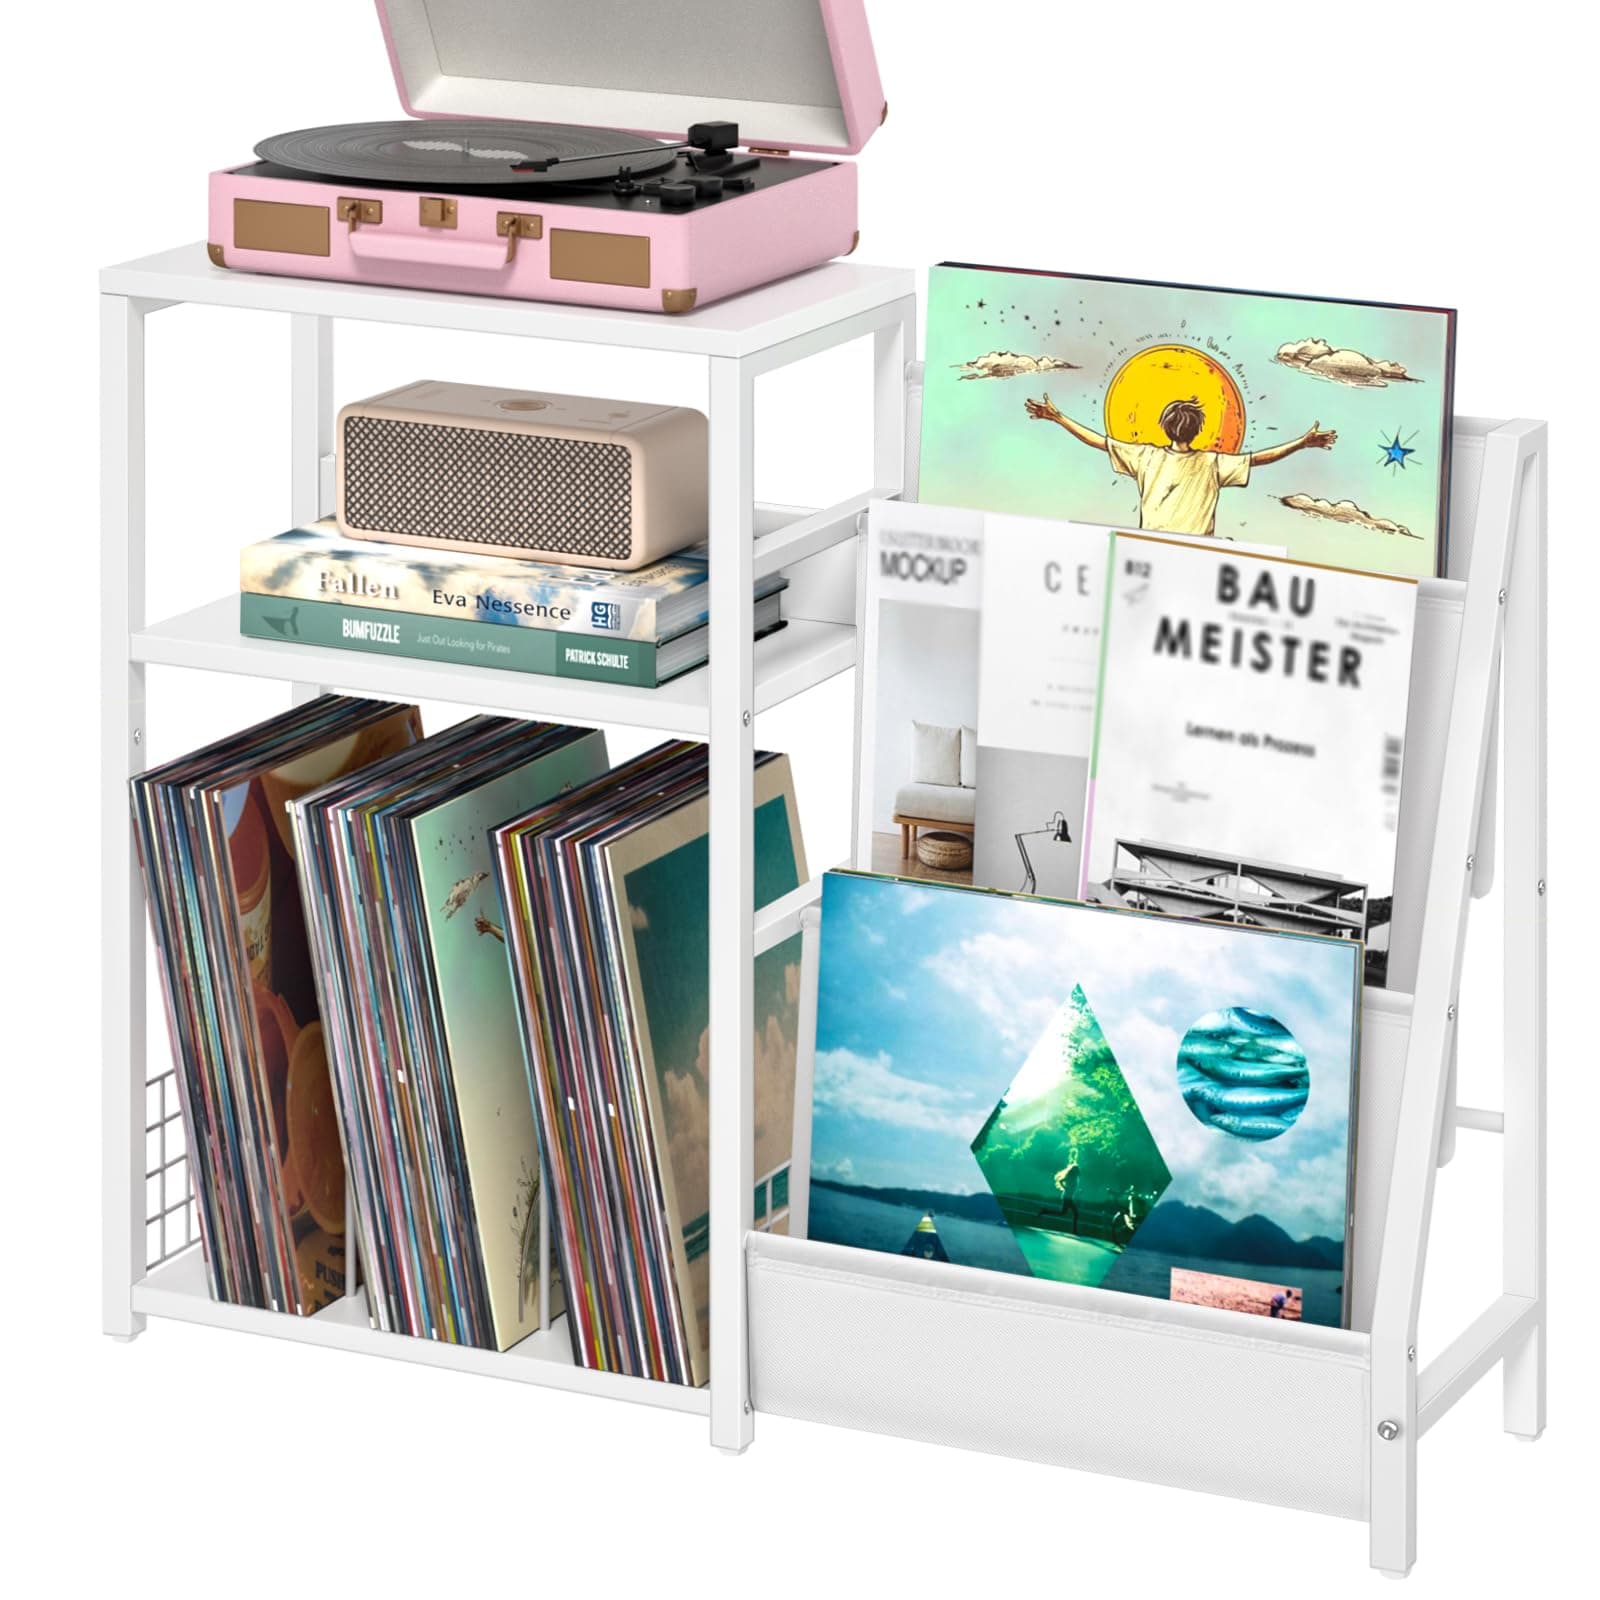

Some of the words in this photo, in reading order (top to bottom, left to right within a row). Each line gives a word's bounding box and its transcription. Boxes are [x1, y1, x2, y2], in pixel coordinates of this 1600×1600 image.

[880, 550, 968, 586] MOCKUP
[319, 571, 401, 602] Fallen
[1217, 562, 1316, 618] BAU
[432, 588, 468, 608] Eva
[475, 594, 573, 621] Nessence
[591, 601, 608, 628] HG
[342, 617, 401, 645] BUMFUZZLE
[416, 631, 431, 645] Just
[432, 633, 446, 648] Out
[447, 637, 475, 653] Looking
[475, 639, 487, 651] for
[487, 641, 511, 655] Pirates
[565, 647, 597, 666] PATRICK
[597, 651, 630, 670] SCHULTE
[1153, 615, 1363, 689] MEISTER
[1184, 721, 1234, 745] Lernen
